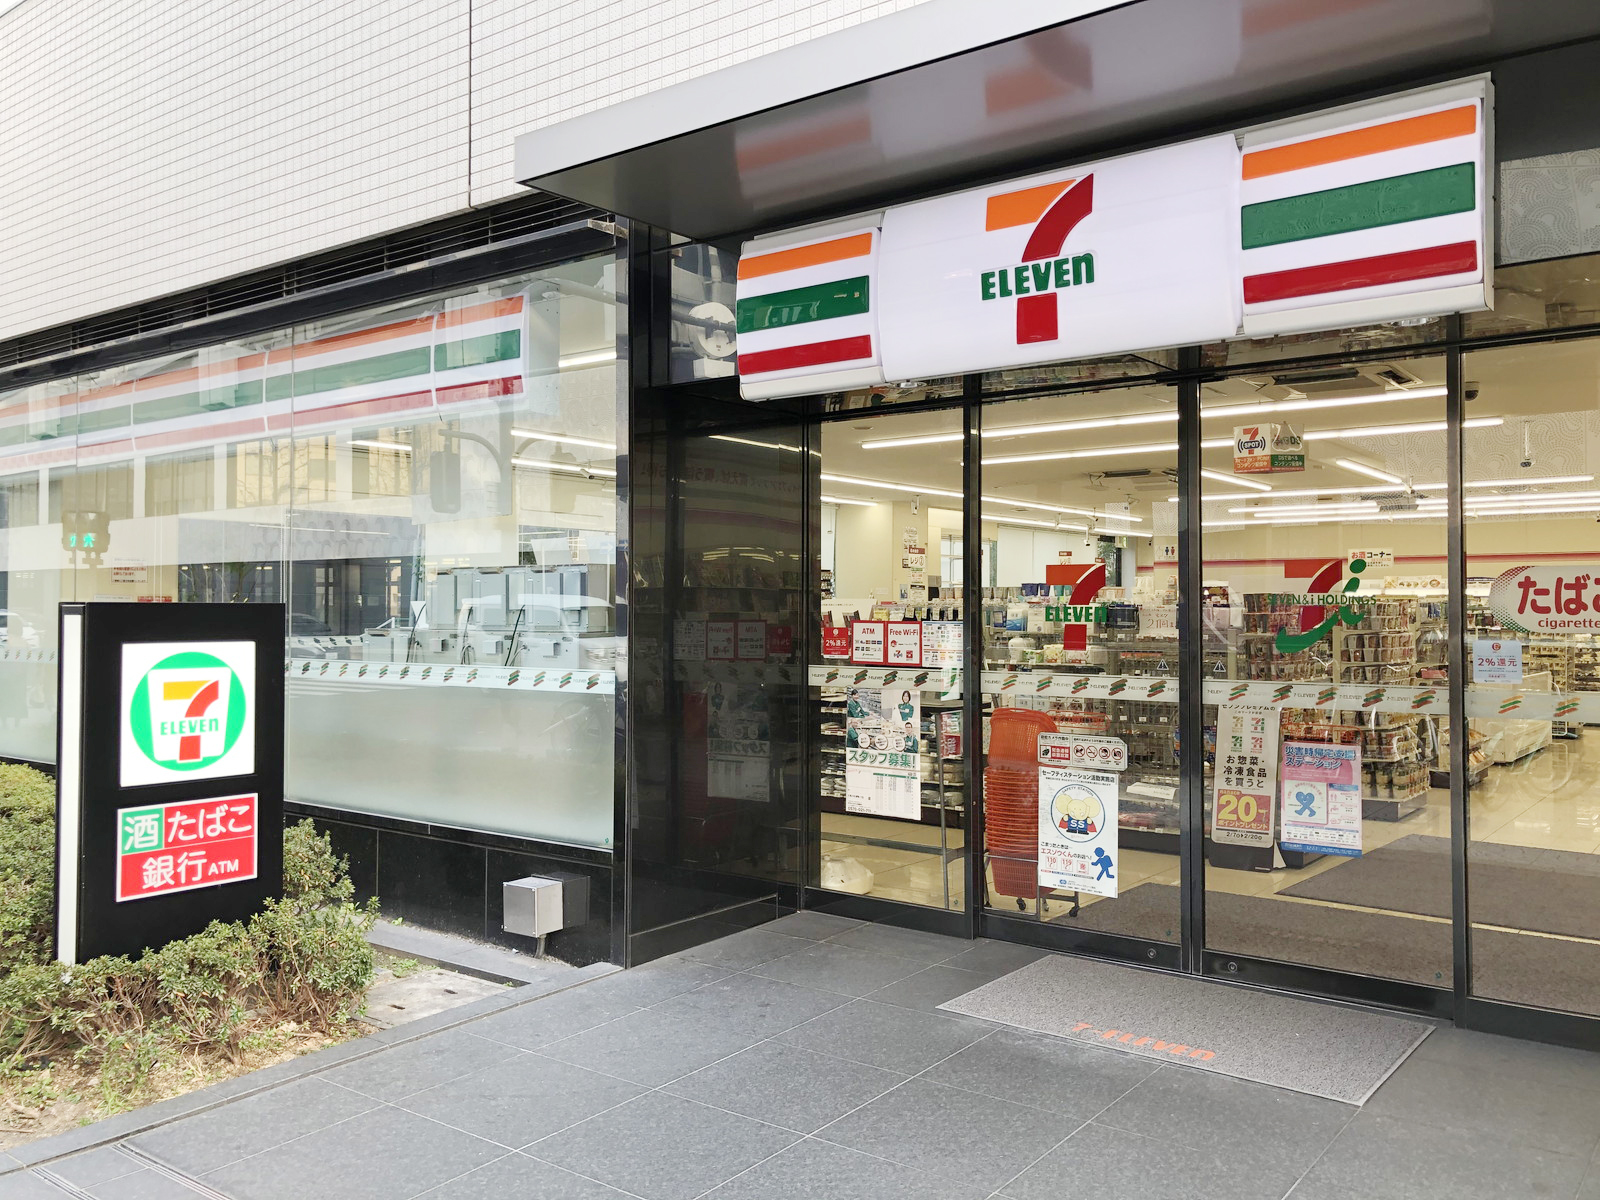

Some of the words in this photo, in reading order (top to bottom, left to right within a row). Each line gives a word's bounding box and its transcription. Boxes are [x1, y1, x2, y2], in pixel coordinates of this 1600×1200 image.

[1244, 441, 1259, 449] SPOT
[1517, 573, 1600, 616] たば
[889, 628, 902, 636] Free
[1285, 756, 1343, 770] ステーション
[1223, 766, 1267, 777] 冷凍食品
[1224, 777, 1264, 788] を買うと
[1218, 794, 1257, 822] 20
[124, 814, 160, 851] 酒
[168, 804, 252, 843] たばこ
[1070, 819, 1085, 829] SS
[1218, 820, 1268, 829] ポイントプレゼント
[142, 851, 207, 889] 銀行
[208, 859, 239, 876] ATM
